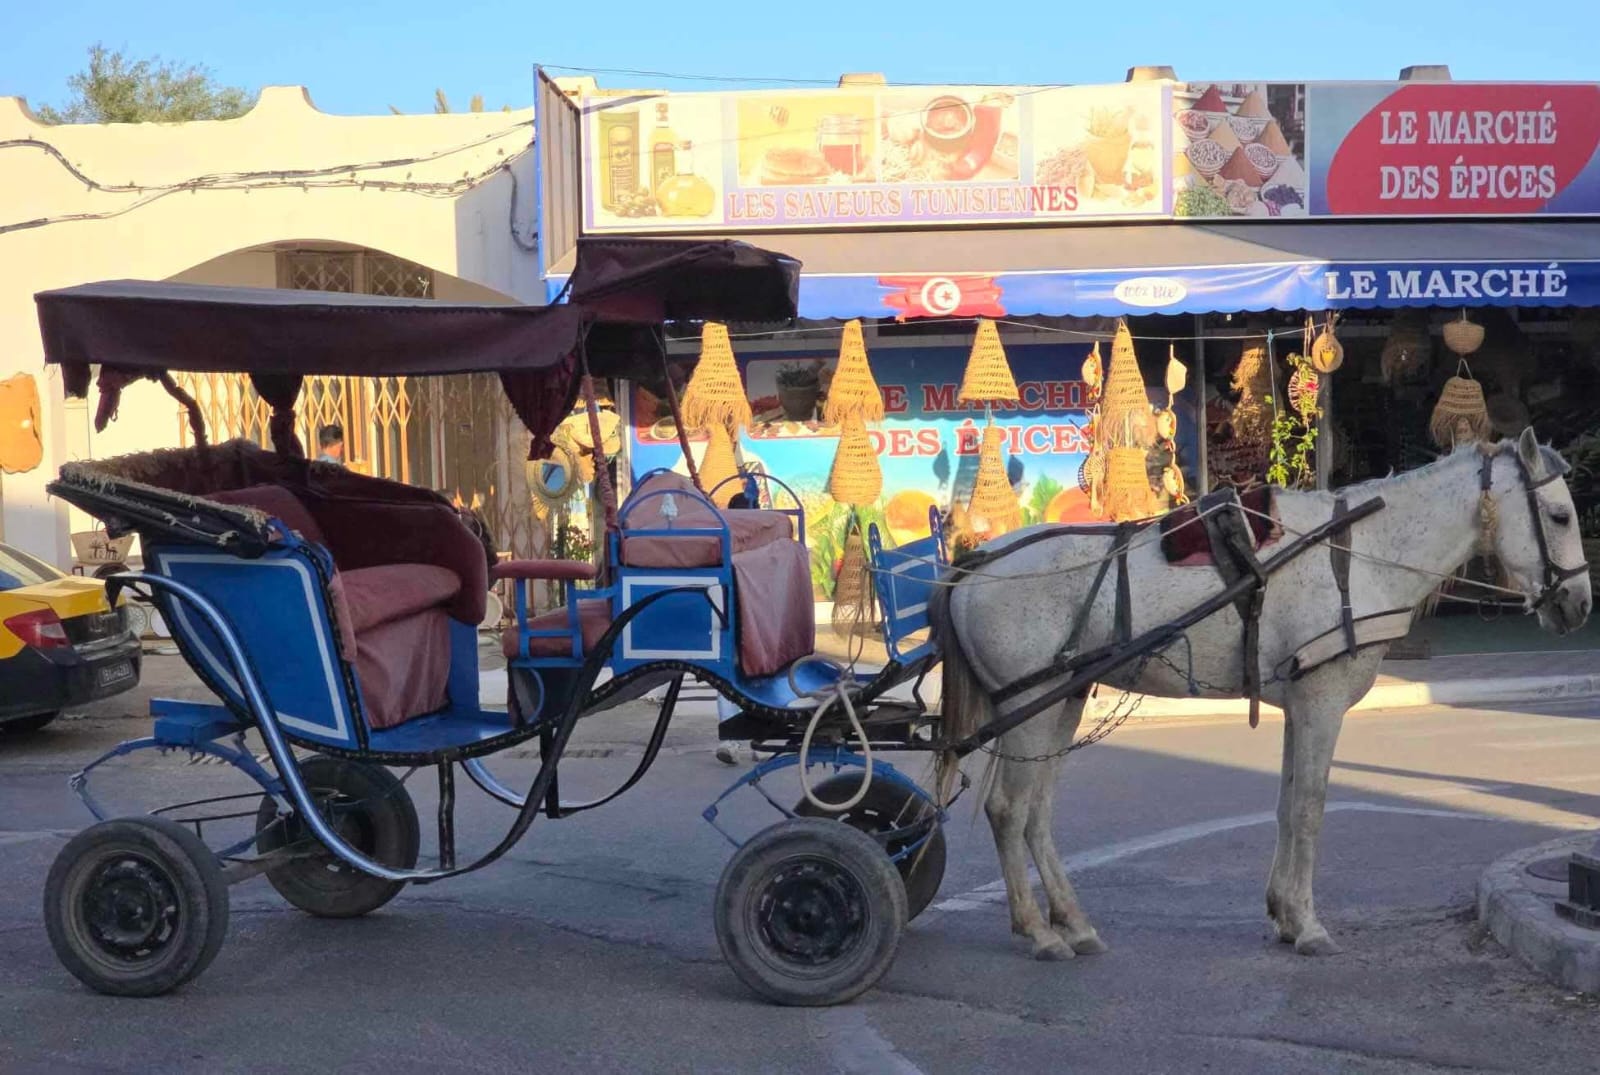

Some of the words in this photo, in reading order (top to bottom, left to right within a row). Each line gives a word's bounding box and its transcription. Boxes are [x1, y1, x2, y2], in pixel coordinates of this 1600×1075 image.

[1380, 111, 1418, 145] LE
[1427, 101, 1557, 145] MARCHÉ
[1380, 165, 1440, 199] DES
[1449, 155, 1556, 199] ÉPICES
[728, 191, 777, 220] LES
[784, 189, 902, 218] SAVEURS
[911, 186, 1078, 215] TUNISIENNES
[1325, 270, 1378, 300] LE
[1387, 262, 1568, 299] MARCHÉ
[920, 380, 1101, 414] MCH
